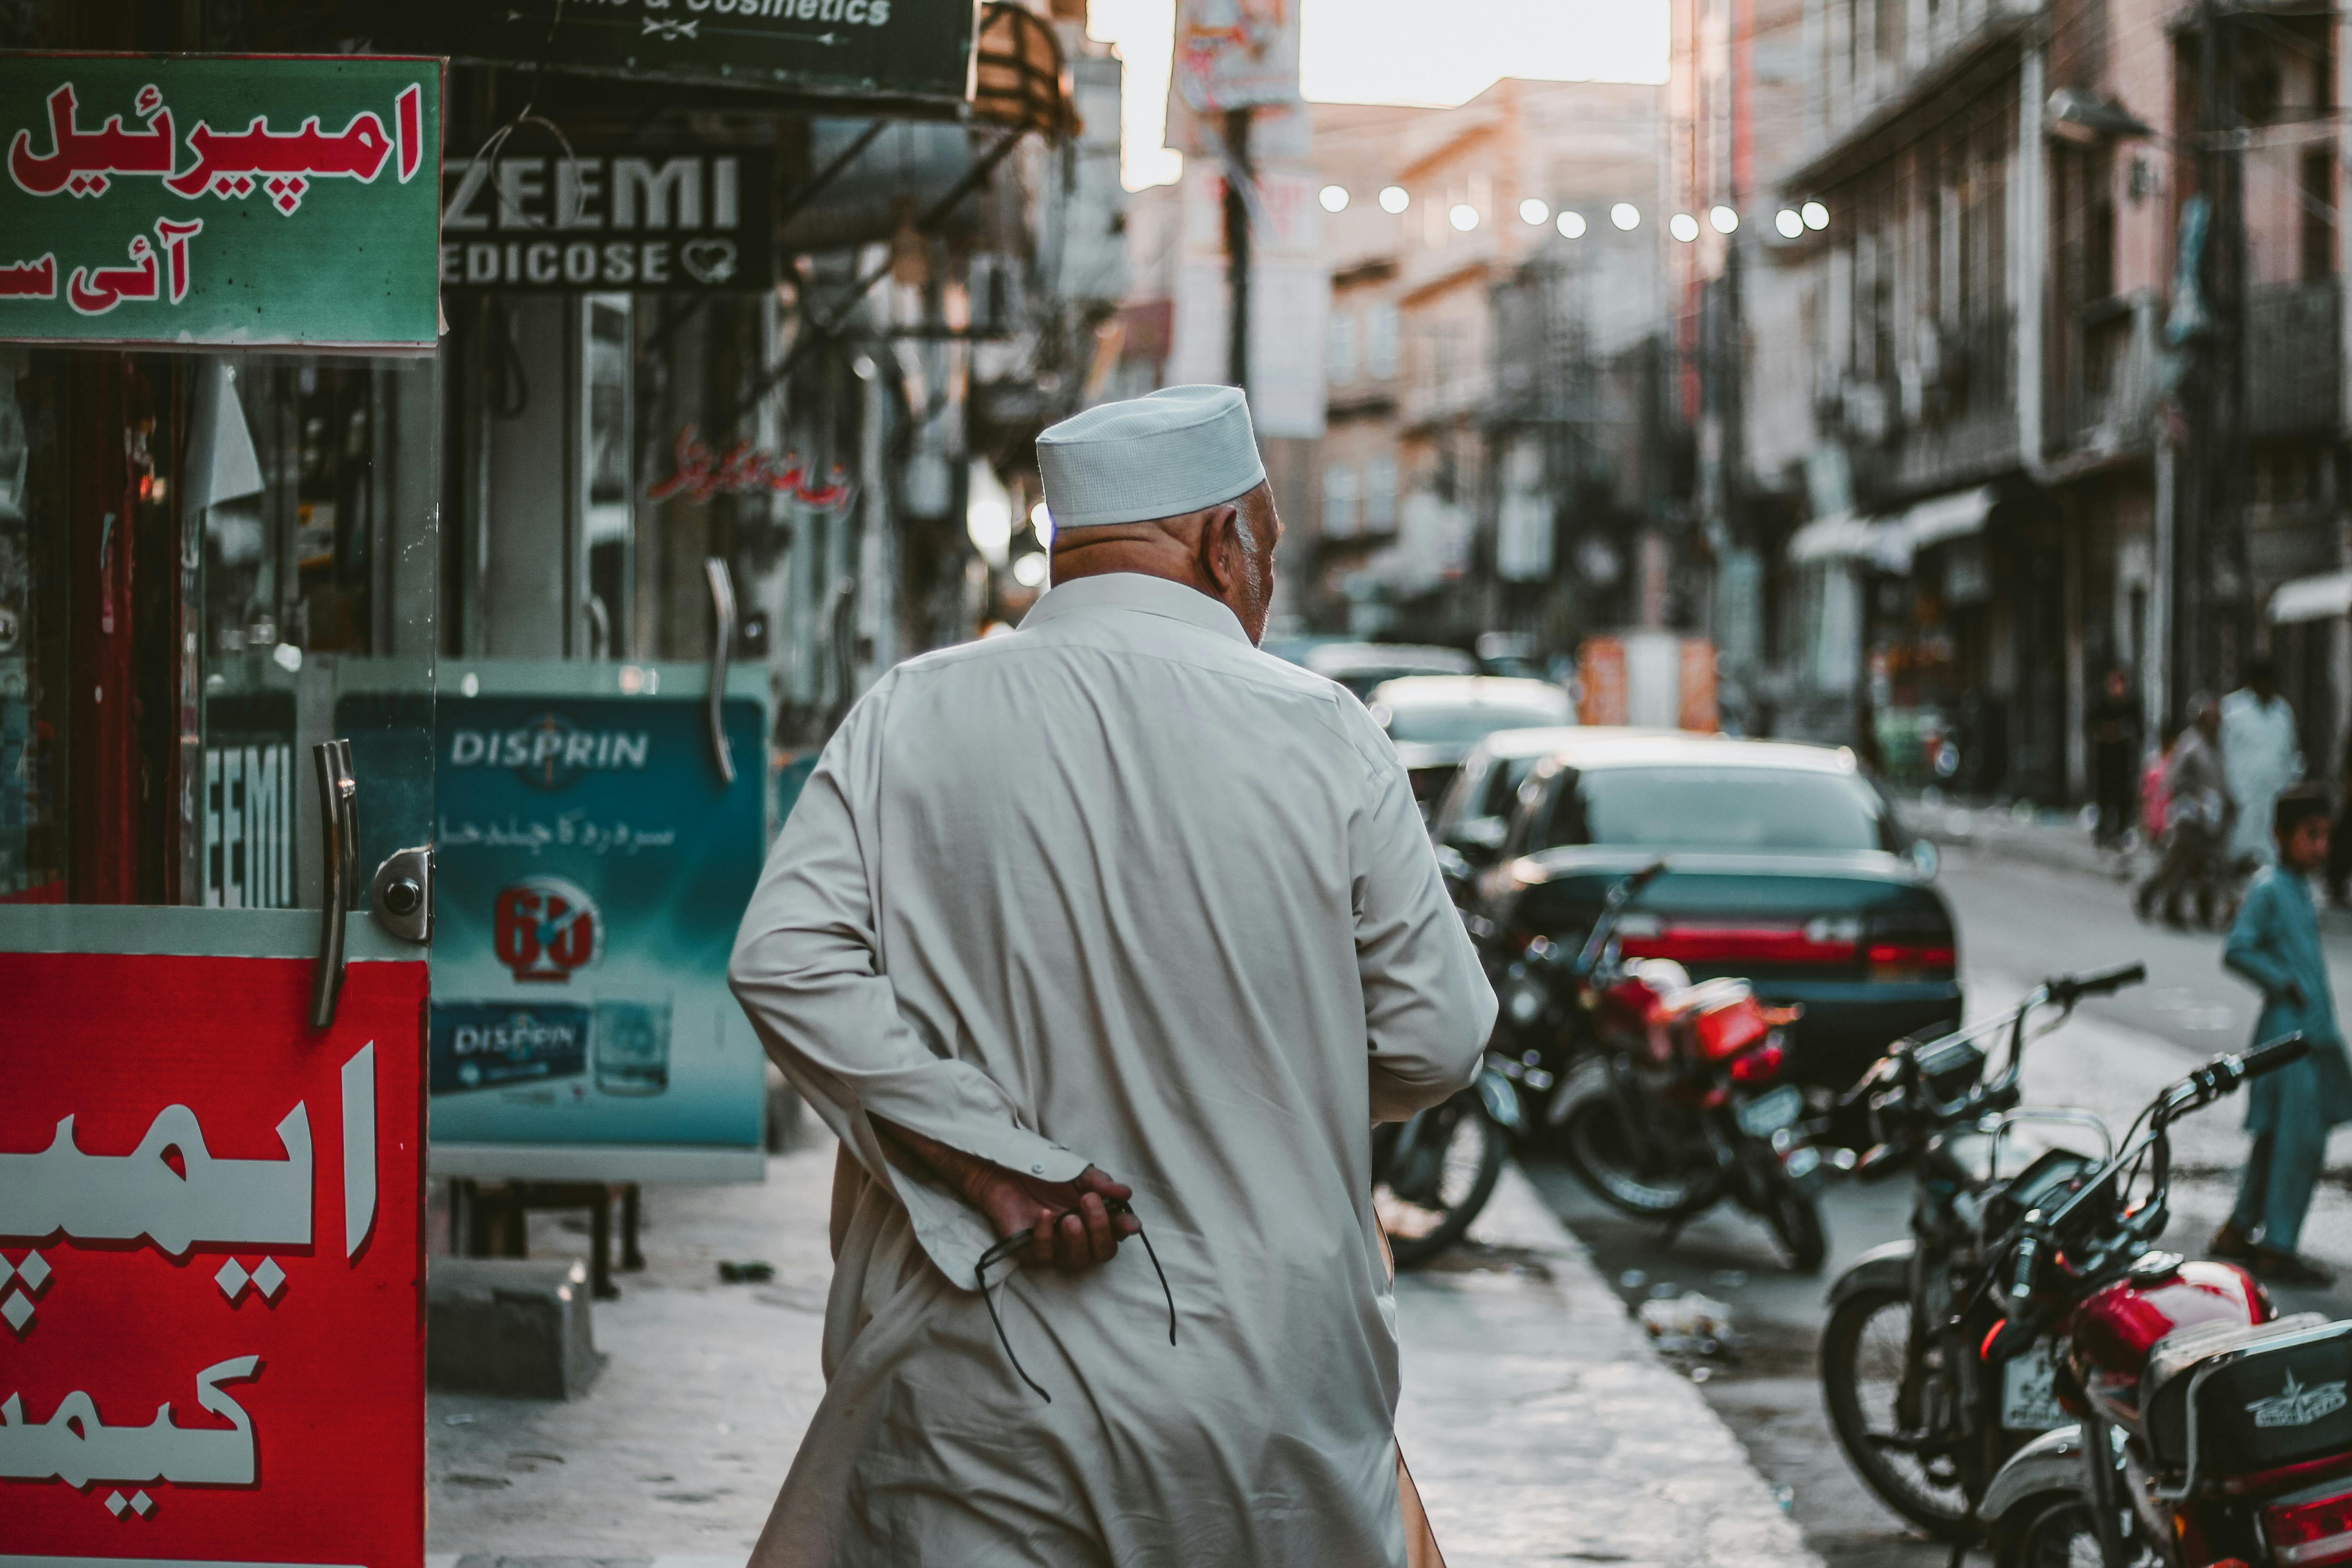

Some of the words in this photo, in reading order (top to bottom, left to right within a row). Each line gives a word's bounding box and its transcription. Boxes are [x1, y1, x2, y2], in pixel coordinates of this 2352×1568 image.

[443, 157, 738, 228] ZEEMI
[67, 216, 204, 315] آئی
[451, 729, 649, 768] DISPRIN
[495, 886, 593, 969] 60
[454, 1022, 578, 1055] DISPRIN
